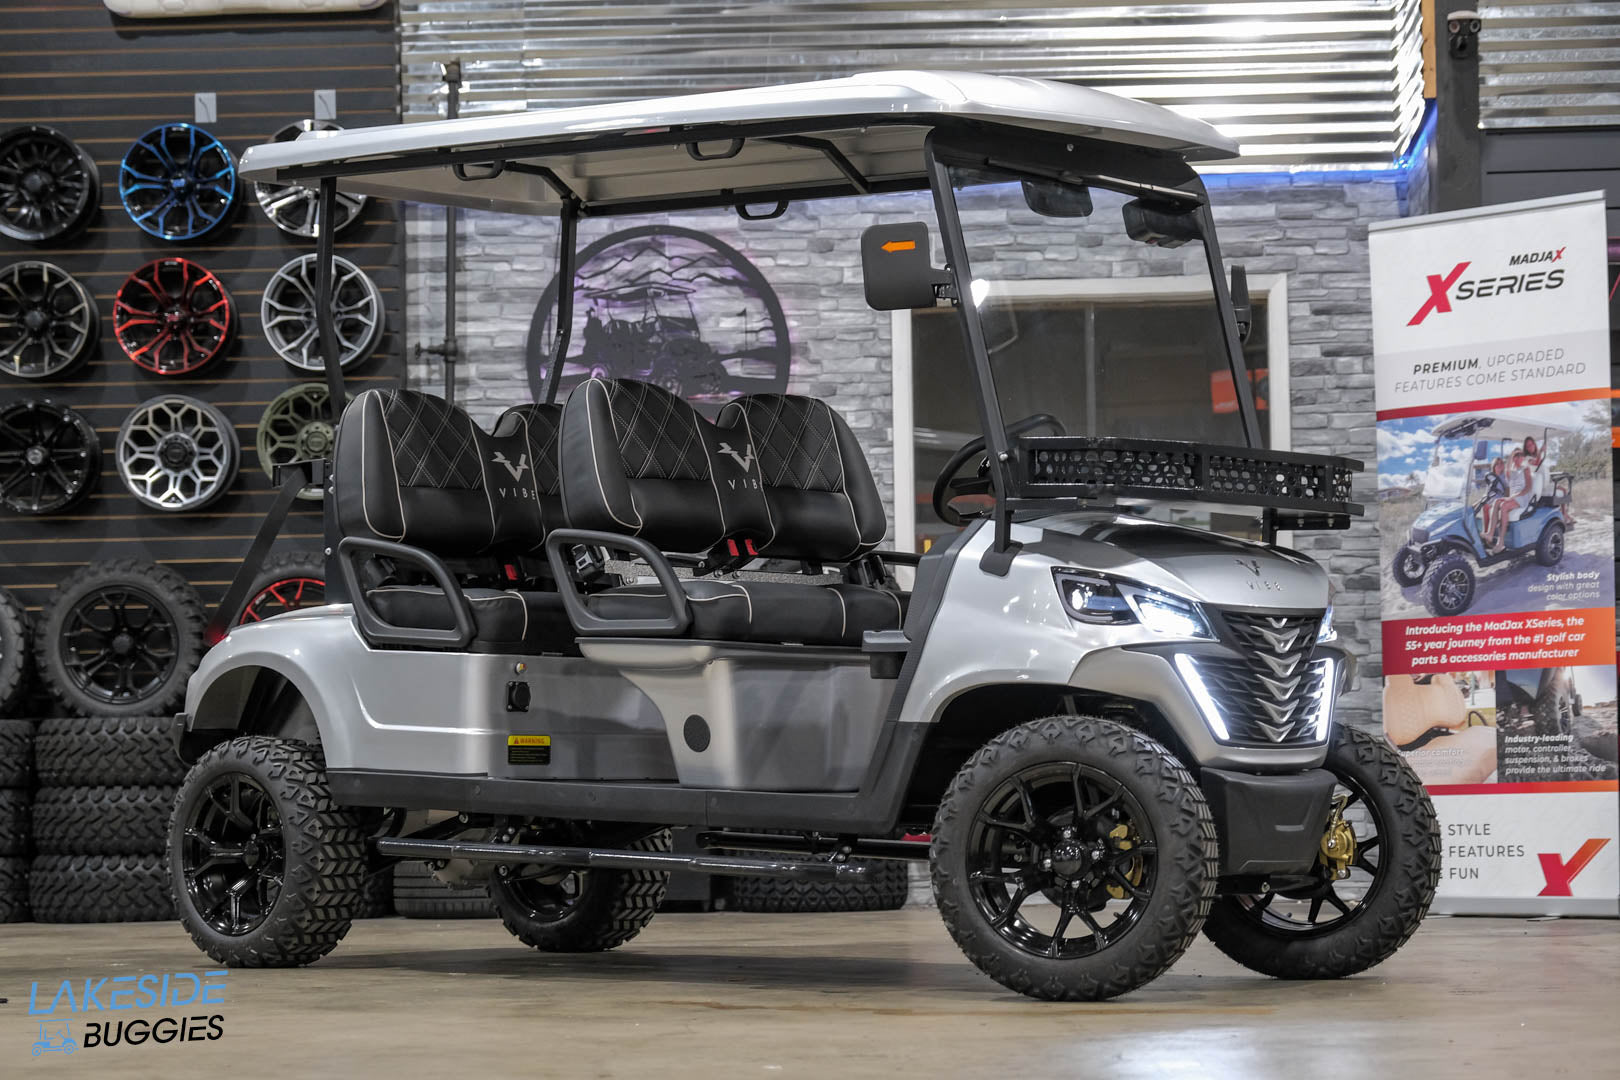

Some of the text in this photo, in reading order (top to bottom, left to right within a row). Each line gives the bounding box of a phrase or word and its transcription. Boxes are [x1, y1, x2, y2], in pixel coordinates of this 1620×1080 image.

[1509, 246, 1567, 266] MADJAX
[1487, 348, 1565, 368] UPGRADED
[1394, 362, 1586, 393] FEATURES COME STANDARD
[727, 478, 760, 490] VIB
[499, 487, 536, 500] VIBE
[1546, 571, 1600, 582] Stylish body
[1246, 580, 1282, 591] VIBE
[1527, 581, 1600, 593] design with great
[1405, 616, 1584, 636] Introducing the MadJax XSeries, the
[1405, 632, 1586, 652] 55+ year journey from the #1 golf car
[1411, 648, 1580, 668] parts & accessories manufacturer
[1504, 733, 1574, 744] Industry-leading
[1505, 746, 1531, 754] motor,
[1561, 754, 1589, 763] brakes
[1505, 763, 1607, 776] provide the ultimate ride
[1448, 824, 1491, 836] STYLE
[1449, 845, 1524, 858] FEATURES
[1449, 868, 1479, 879] FUN
